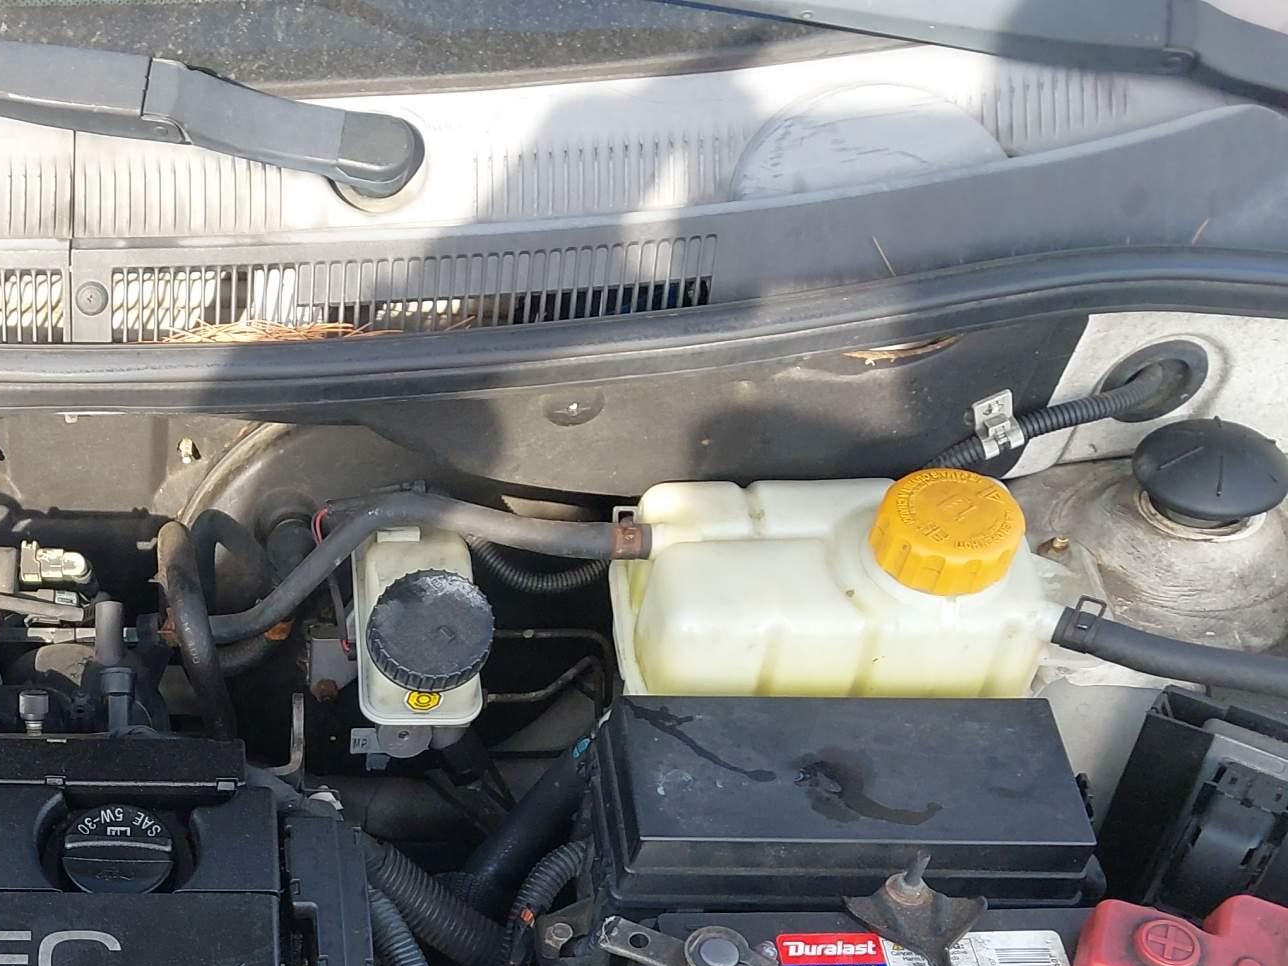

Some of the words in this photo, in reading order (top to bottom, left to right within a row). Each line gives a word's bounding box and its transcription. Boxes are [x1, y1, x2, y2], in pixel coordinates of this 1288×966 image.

[77, 807, 124, 835] 5W-30
[132, 811, 162, 837] SAE
[782, 939, 877, 957] Duralast
